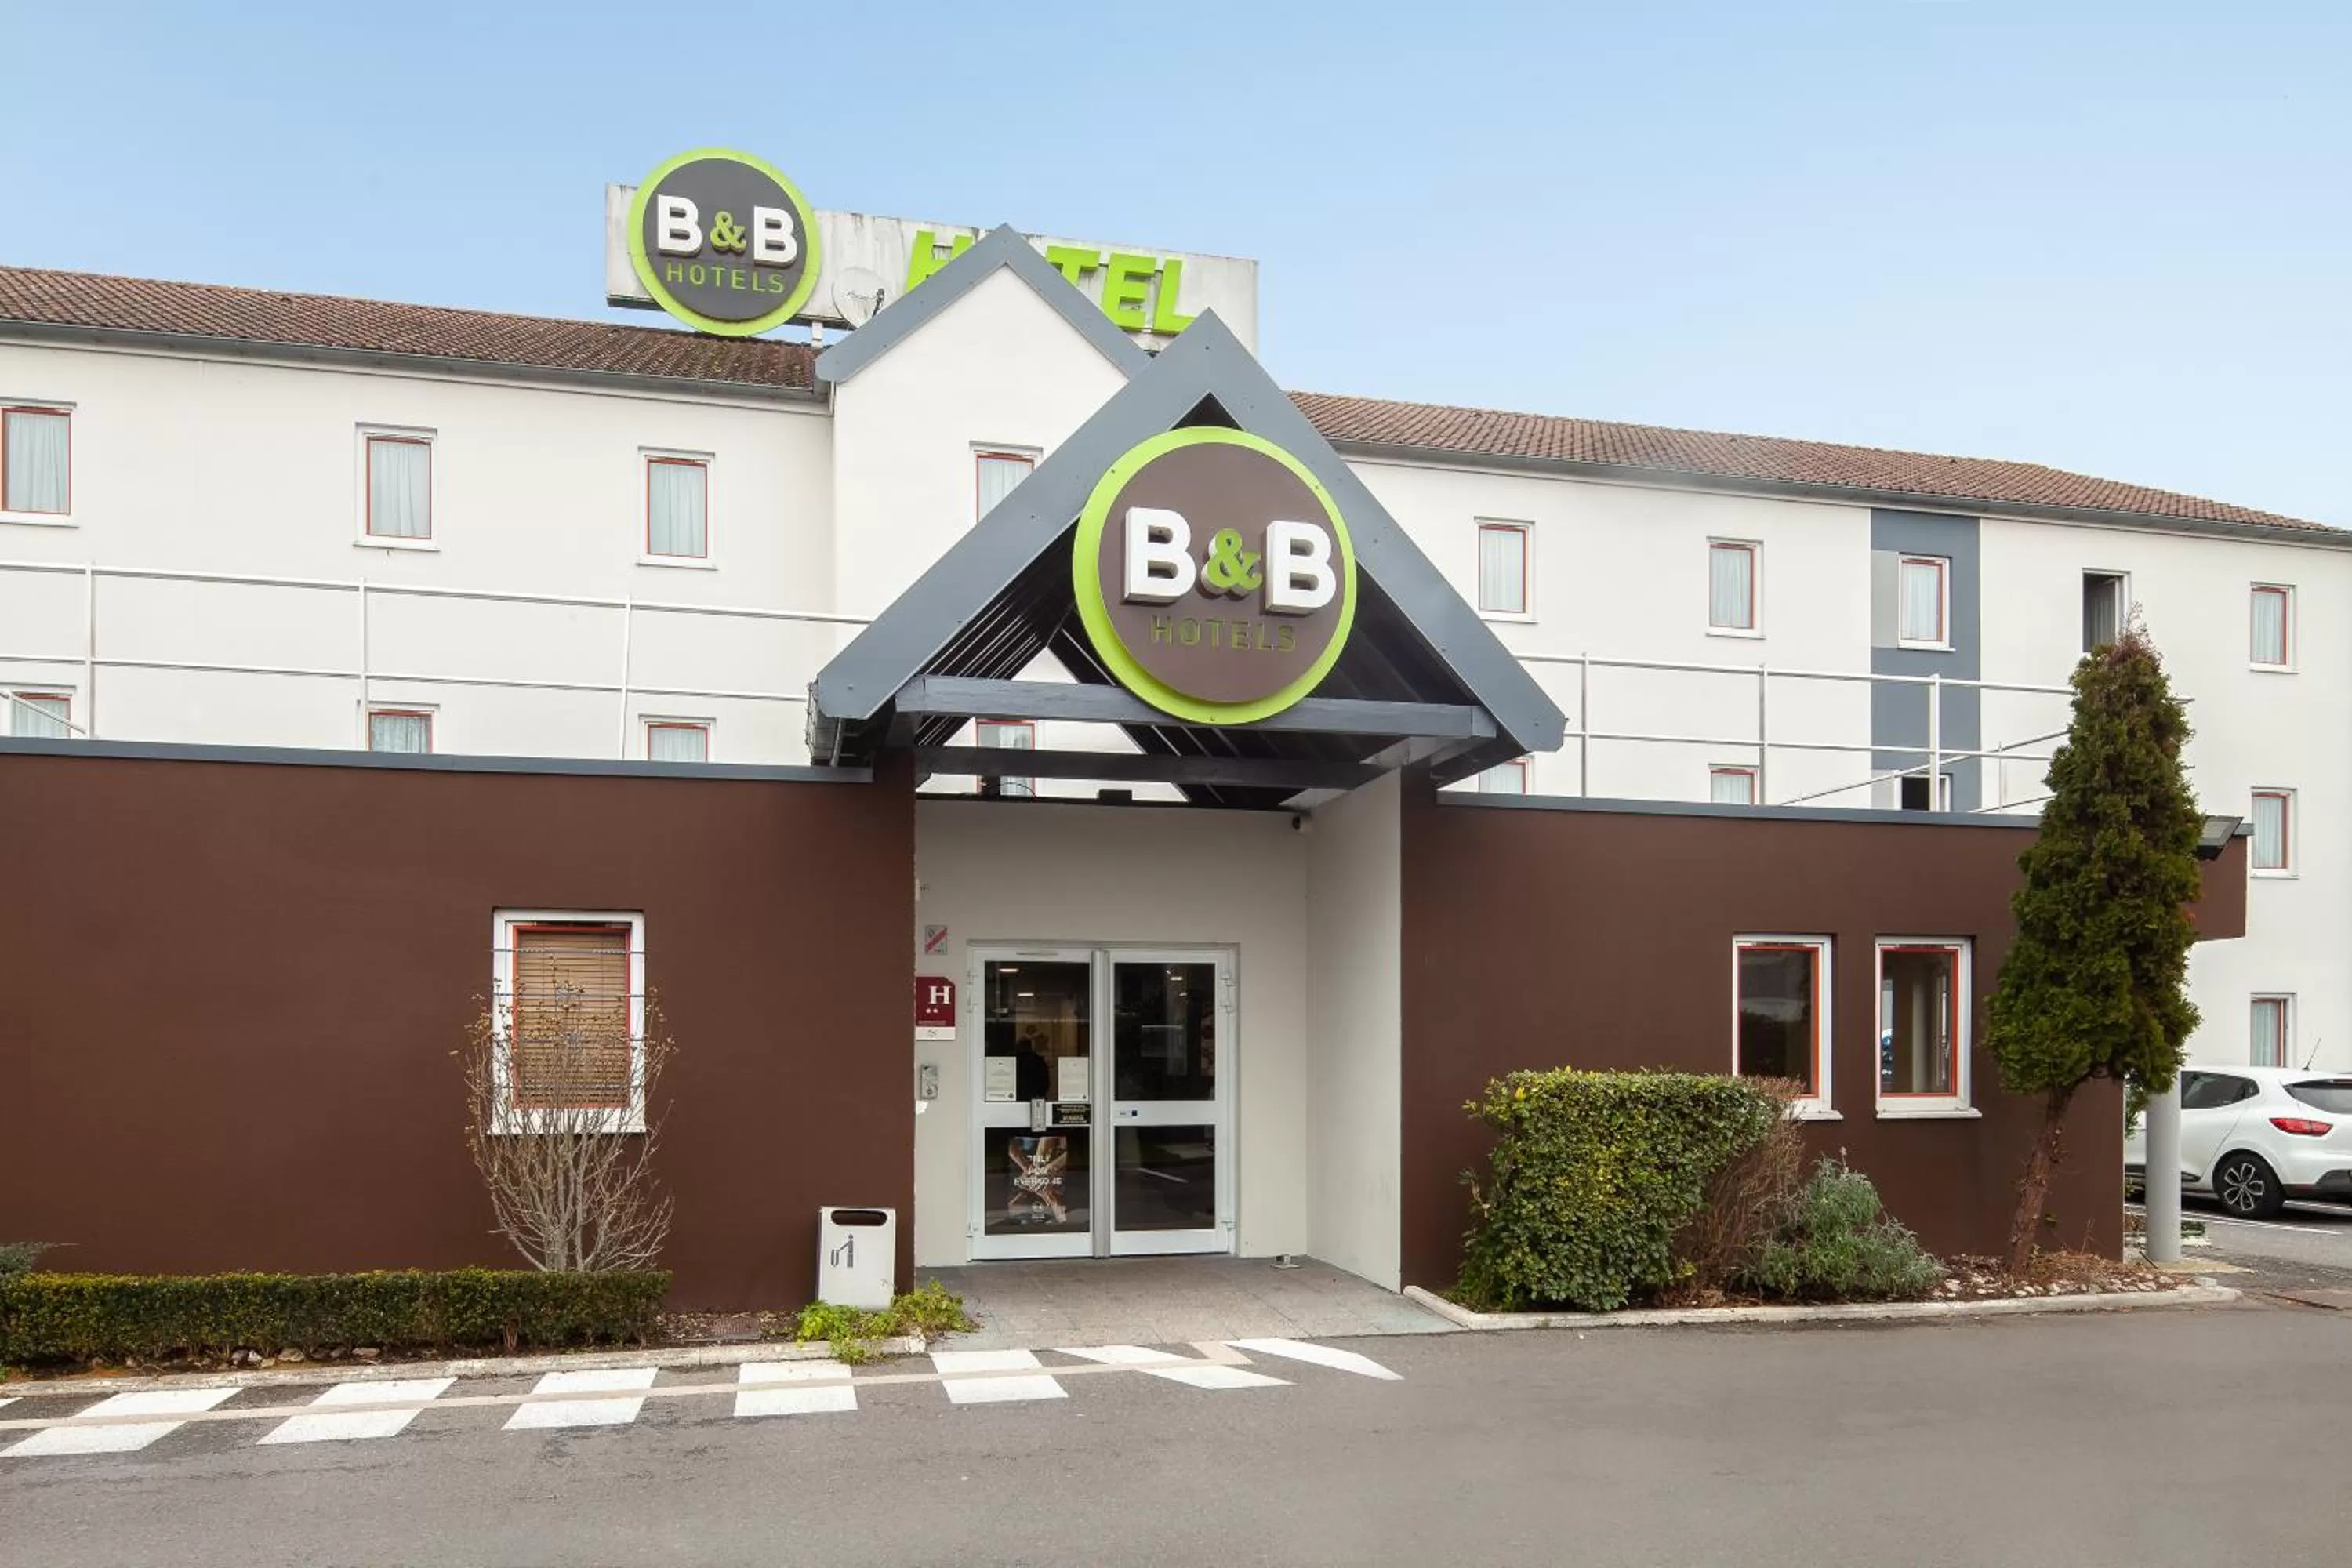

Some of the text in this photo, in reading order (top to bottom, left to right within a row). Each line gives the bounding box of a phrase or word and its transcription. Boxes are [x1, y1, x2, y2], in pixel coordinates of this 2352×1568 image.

[657, 194, 797, 267] B&B
[666, 262, 785, 294] HOTELS
[1123, 506, 1337, 615] B&B
[1150, 613, 1298, 653] HOTELS
[928, 985, 952, 1004] H
